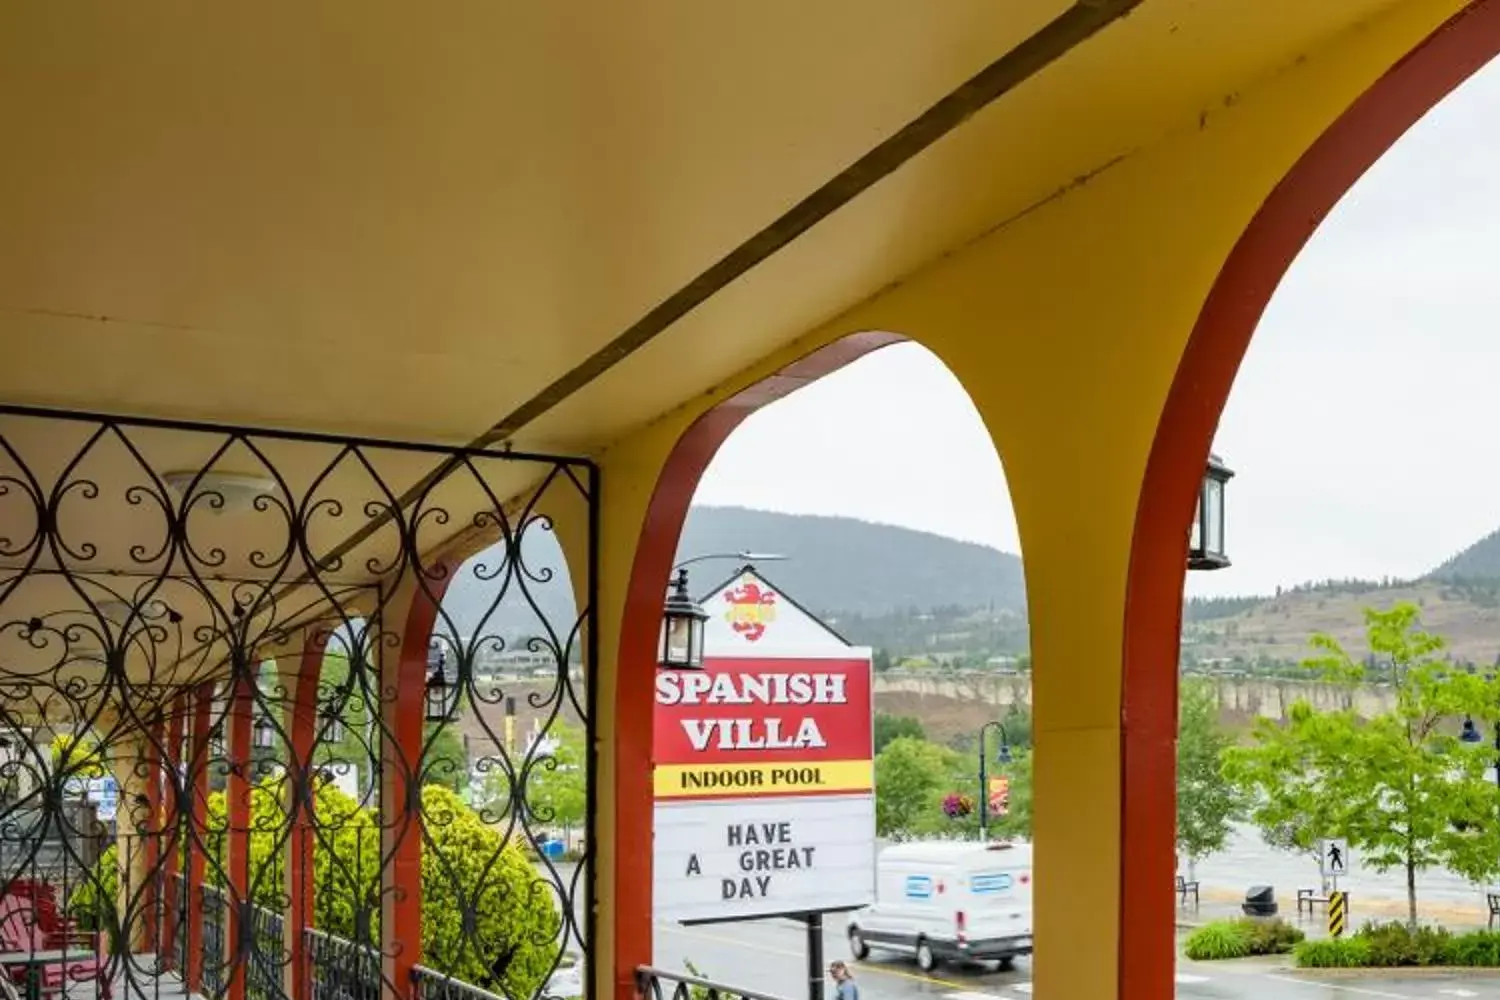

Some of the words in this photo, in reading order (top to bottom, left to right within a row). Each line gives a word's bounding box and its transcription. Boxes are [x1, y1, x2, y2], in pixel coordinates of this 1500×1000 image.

[656, 672, 847, 704] SPANISH
[680, 717, 826, 750] VILLA
[681, 769, 763, 788] INDOOR
[771, 767, 825, 785] POOL
[727, 822, 791, 846] HAVE
[686, 853, 701, 876] A
[739, 847, 815, 871] GREAT
[722, 875, 771, 899] DAY
